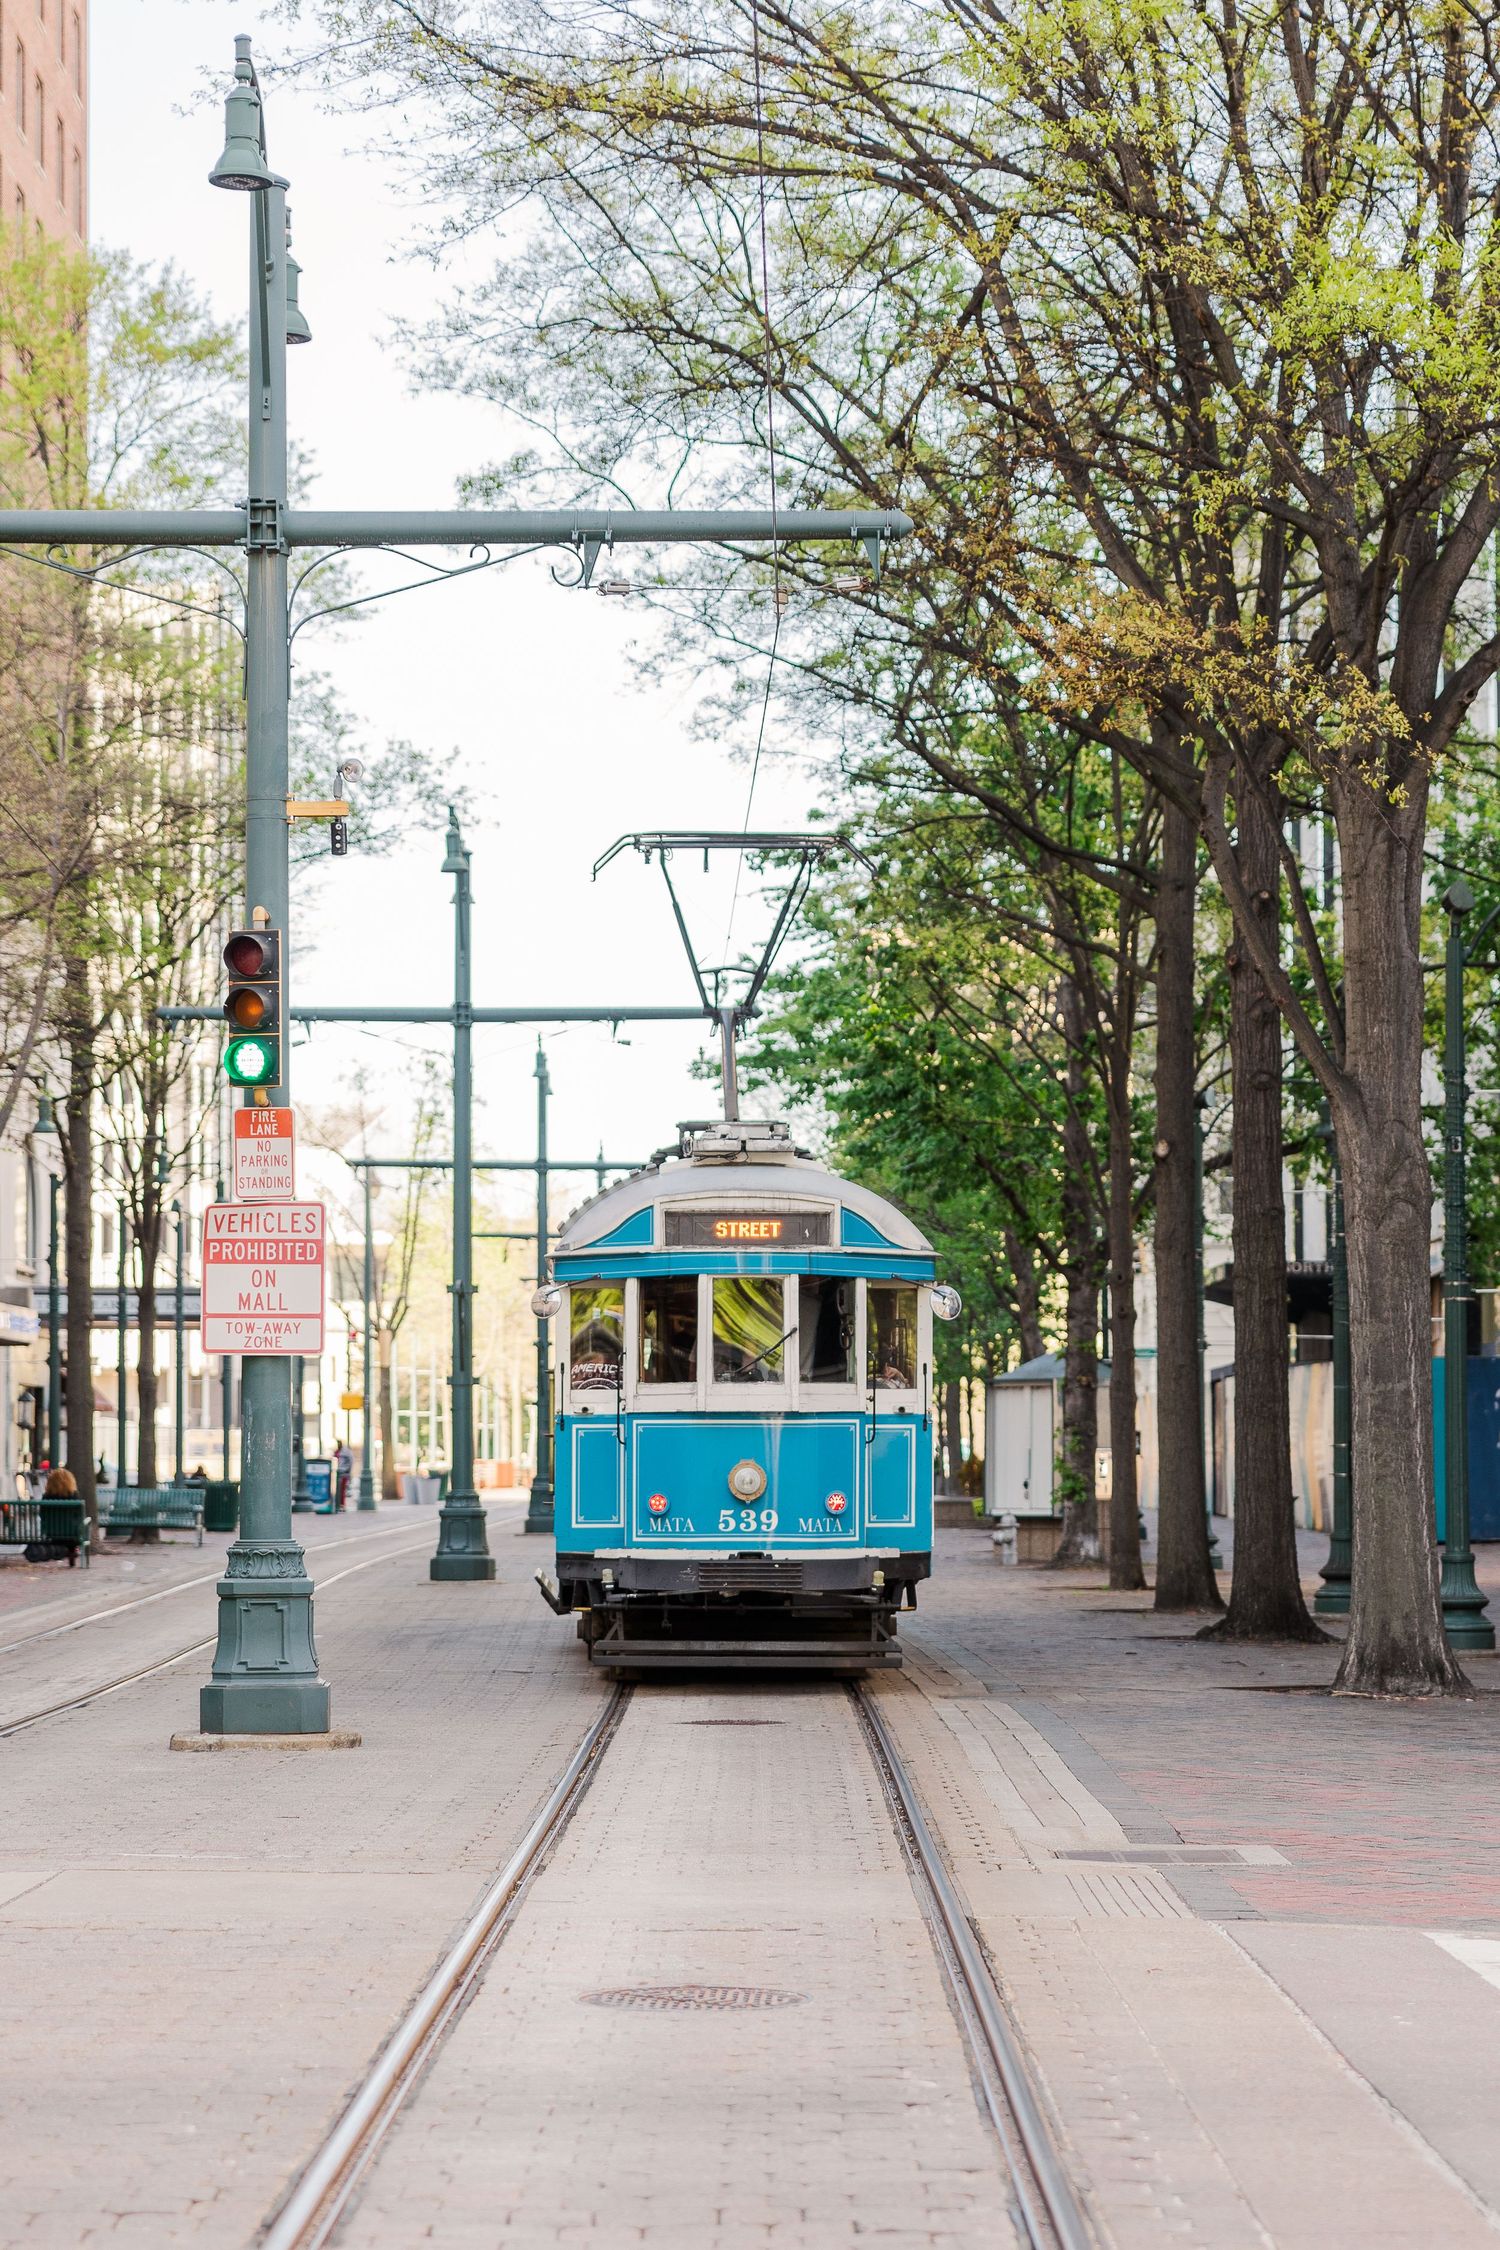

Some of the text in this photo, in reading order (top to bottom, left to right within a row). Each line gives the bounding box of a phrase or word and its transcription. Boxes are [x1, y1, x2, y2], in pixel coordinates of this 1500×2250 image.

[251, 1110, 277, 1123] FIRE
[250, 1123, 279, 1136] LANE
[257, 1140, 271, 1152] NO
[241, 1154, 288, 1167] PARKING
[239, 1176, 291, 1189] STANDING
[213, 1212, 317, 1233] VEHICLES
[715, 1220, 782, 1239] STREET
[209, 1242, 318, 1260] PROHIBITED
[251, 1269, 276, 1288] ON
[238, 1292, 288, 1311] MALL
[226, 1321, 301, 1334] TOW-AWAY
[243, 1336, 283, 1348] ZONE
[571, 1363, 624, 1374] AMERIC
[650, 1517, 695, 1533] MATA
[718, 1509, 779, 1533] 539
[798, 1517, 843, 1533] MATA
